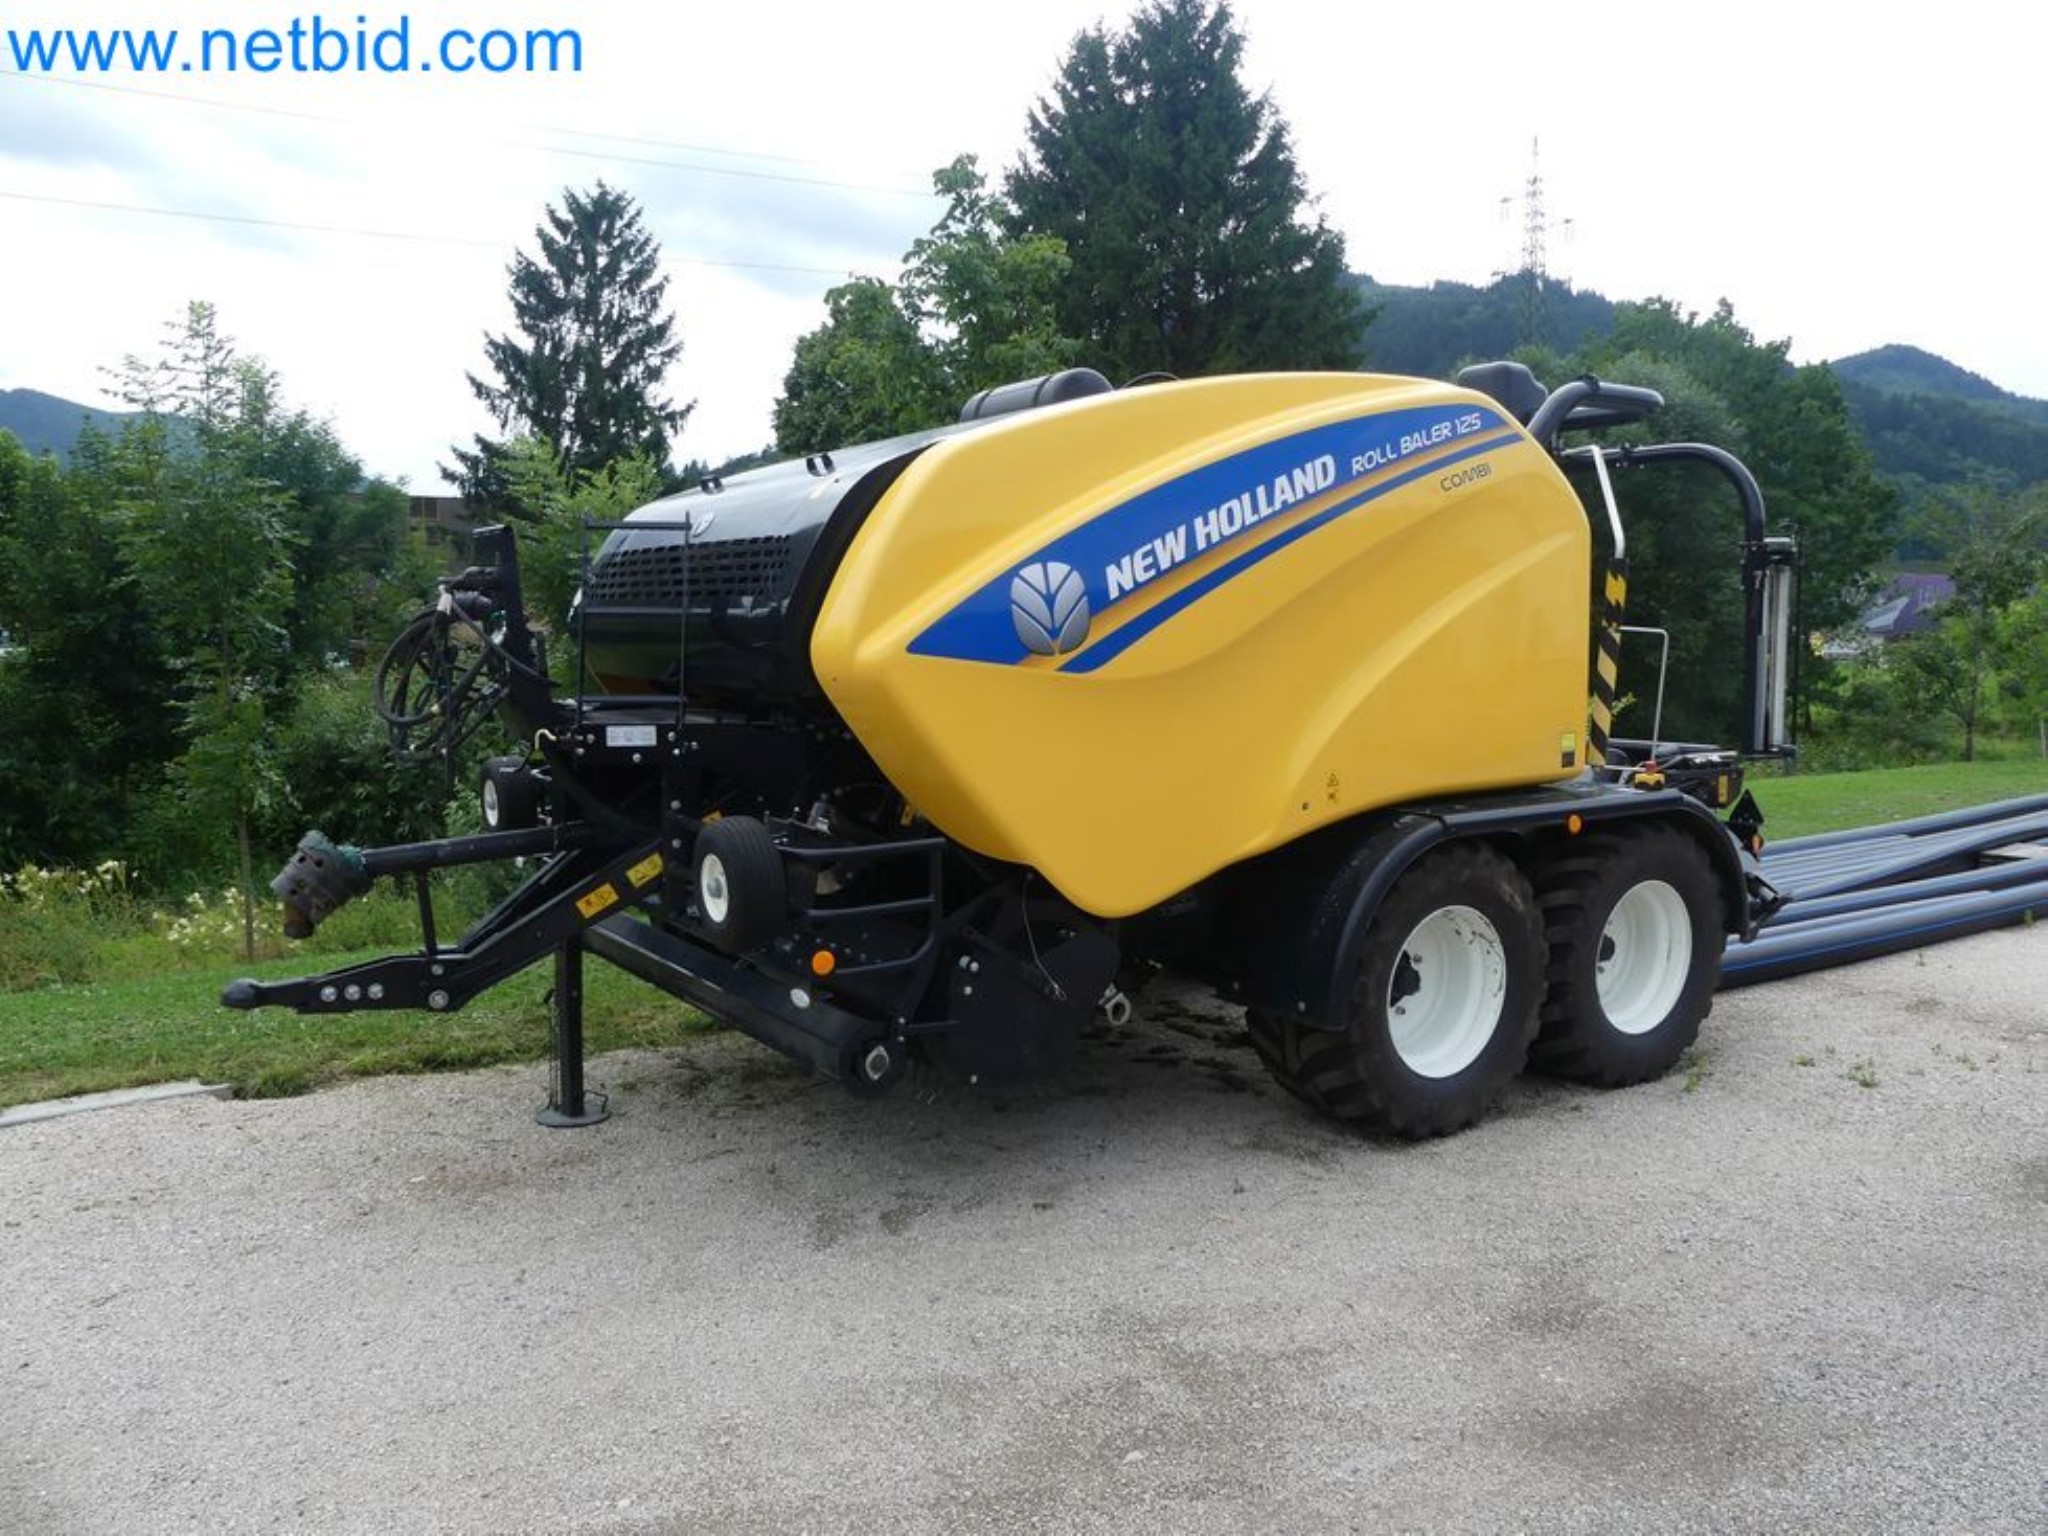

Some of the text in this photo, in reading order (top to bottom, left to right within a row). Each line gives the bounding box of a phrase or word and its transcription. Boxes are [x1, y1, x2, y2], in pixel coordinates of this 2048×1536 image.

[1352, 412, 1482, 476] ROLL BALER 125
[1440, 463, 1491, 492] COMBI
[1105, 454, 1336, 600] NEW HOLLAND
